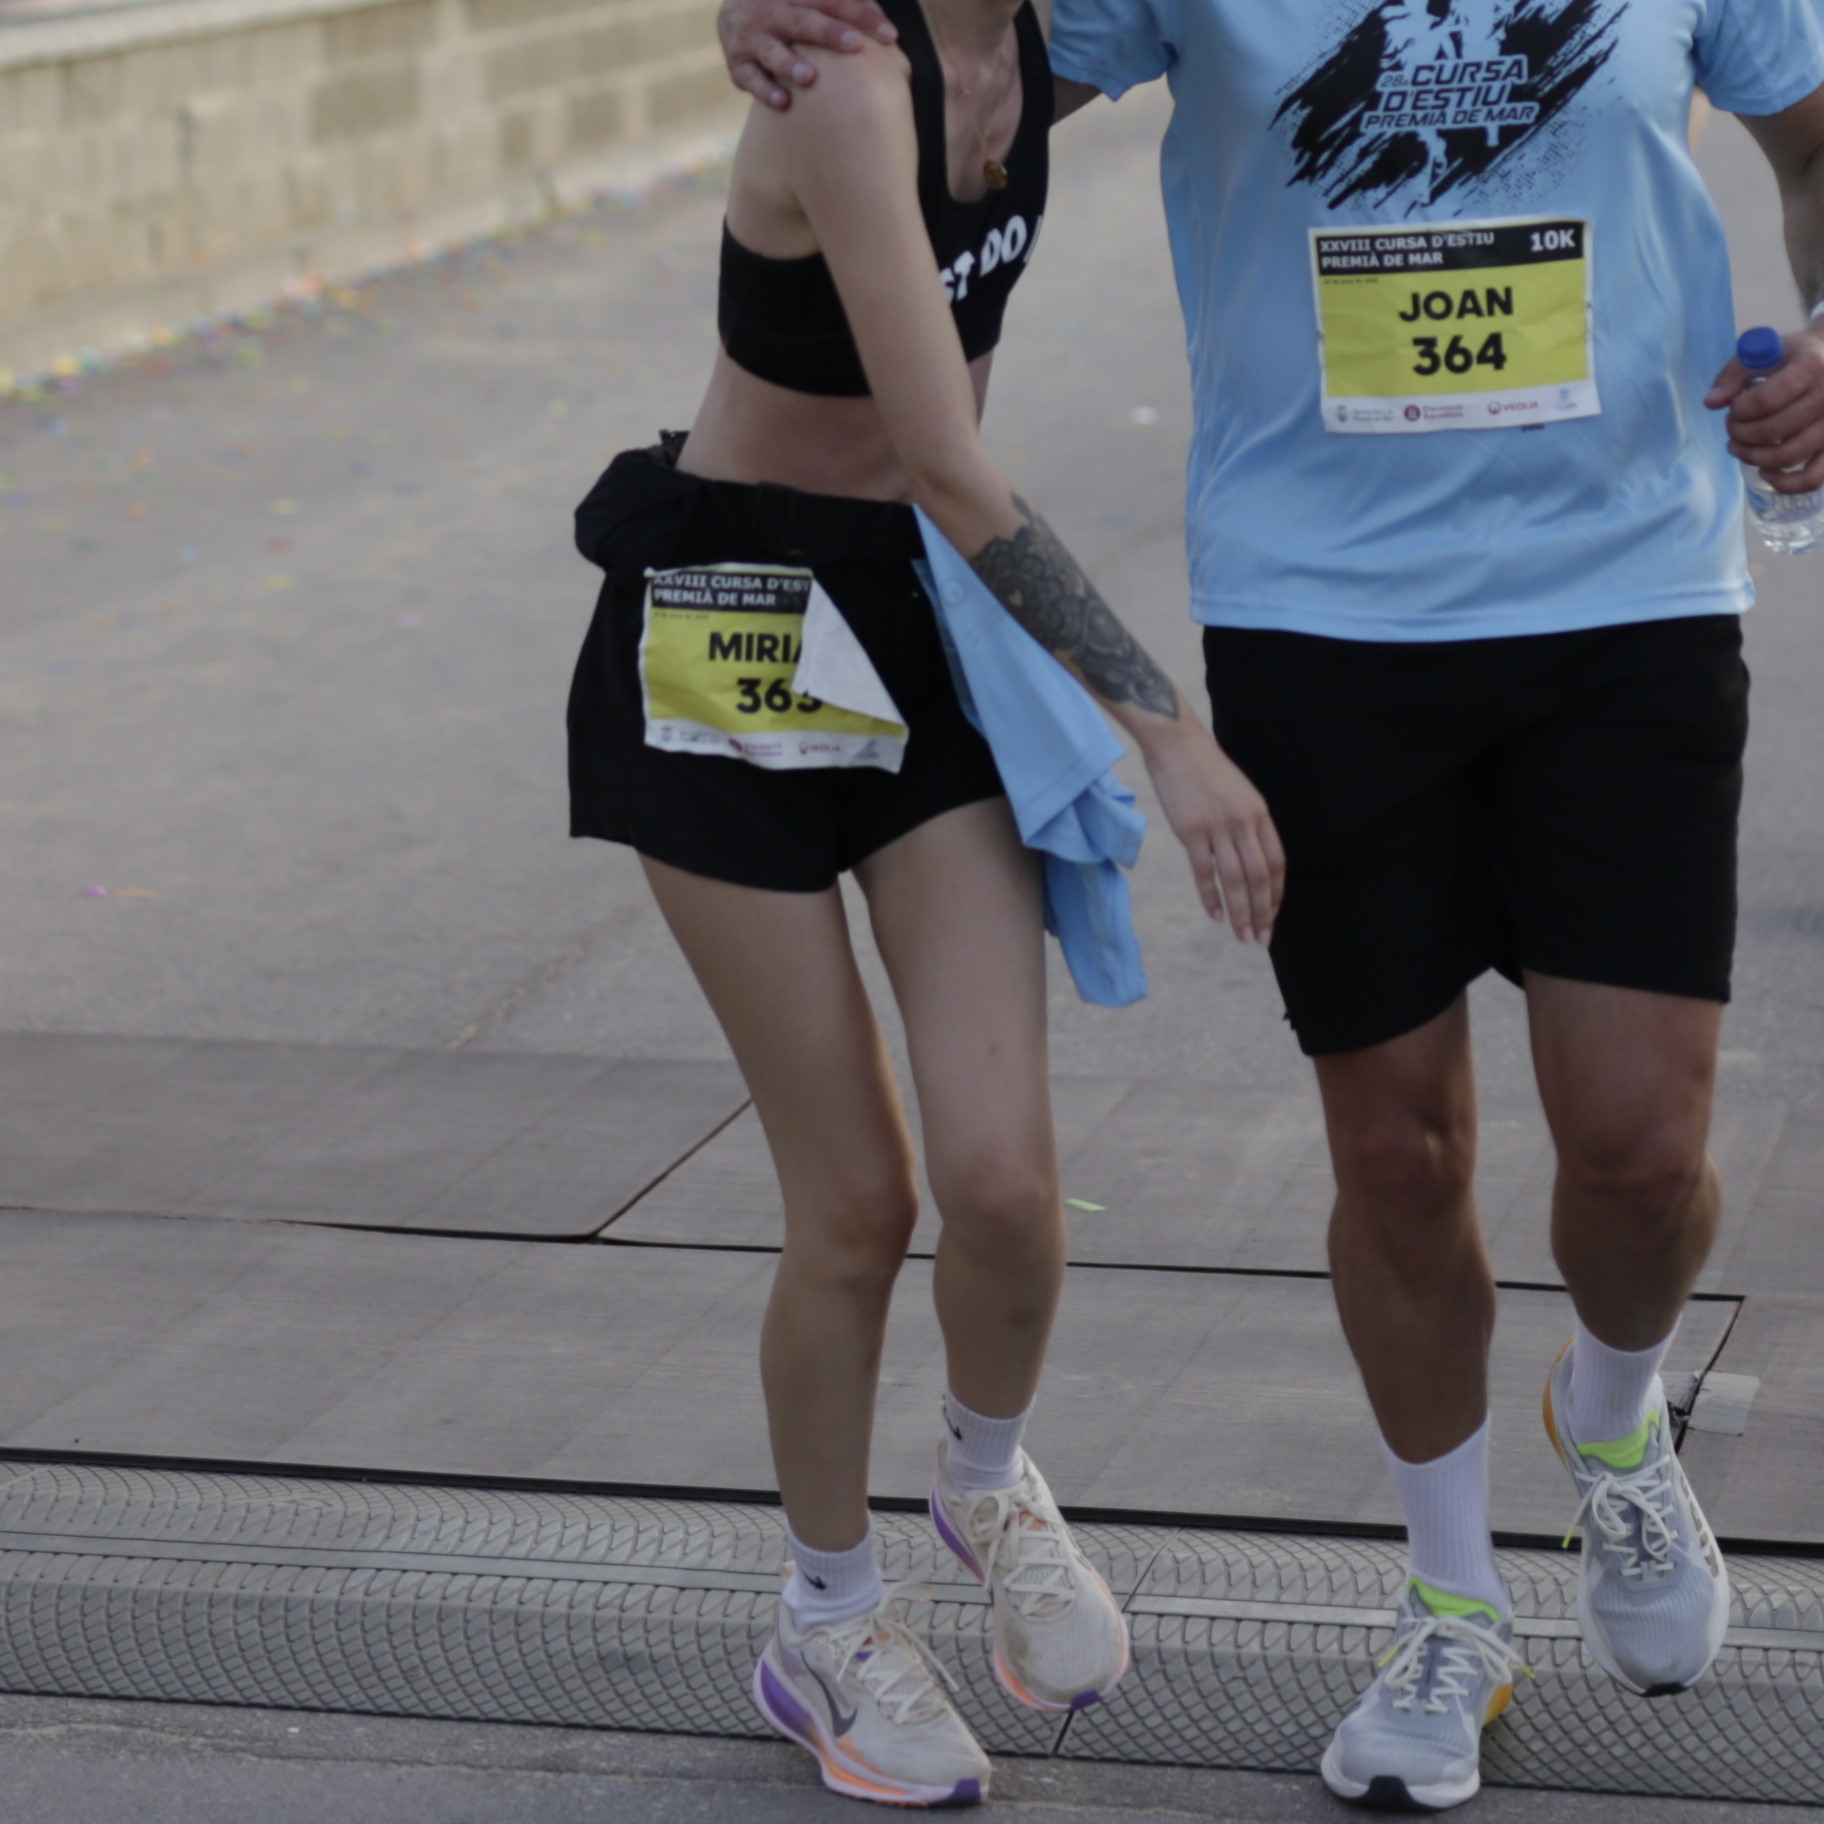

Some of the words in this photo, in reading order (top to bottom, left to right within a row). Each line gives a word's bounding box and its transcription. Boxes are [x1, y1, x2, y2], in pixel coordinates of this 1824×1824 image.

[1411, 59, 1525, 87] CURSA
[1383, 84, 1507, 113] D'ESTIU
[1452, 109, 1482, 125] DE
[1485, 106, 1535, 123] MAR
[979, 214, 1027, 278] DO
[1320, 238, 1371, 253] XXVIII
[1375, 236, 1427, 251] CURSA
[1431, 232, 1495, 249] D'ESTIU
[1530, 229, 1576, 252] 10K
[1384, 254, 1404, 267] DE
[1408, 251, 1443, 266] MAR
[1398, 286, 1514, 323] JOAN
[1412, 331, 1508, 377] 364
[710, 576, 763, 589] CURSA
[717, 592, 739, 605] DE
[742, 593, 776, 606] MAR
